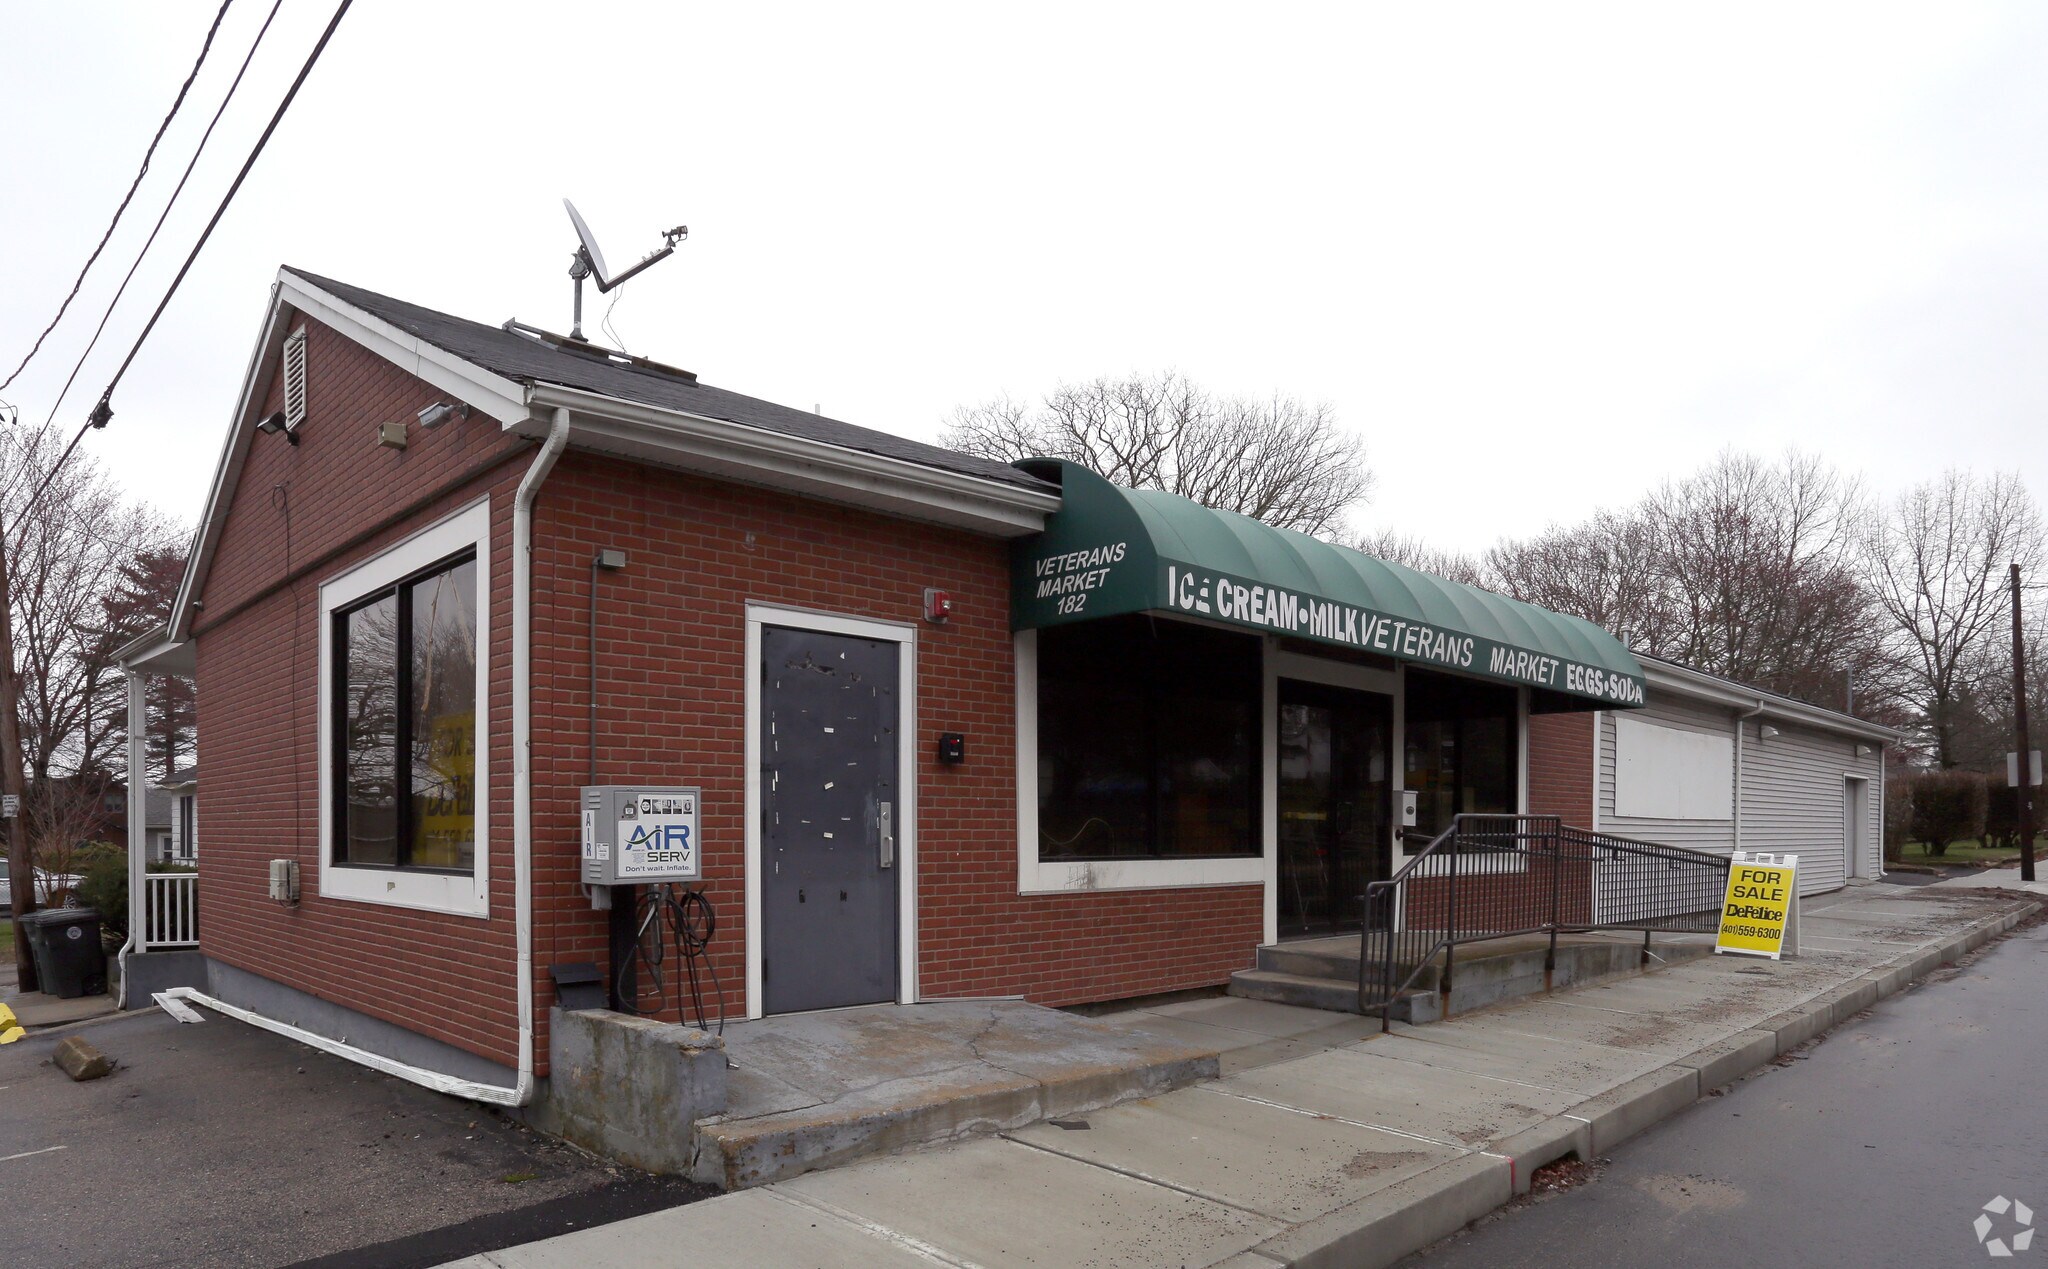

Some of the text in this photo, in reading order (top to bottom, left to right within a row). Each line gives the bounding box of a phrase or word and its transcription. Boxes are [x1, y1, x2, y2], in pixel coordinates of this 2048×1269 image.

[1036, 542, 1126, 577] VETERANS
[1037, 568, 1110, 598] MARKET
[1058, 594, 1086, 615] 182
[1361, 613, 1474, 667] VETERANS
[1490, 647, 1559, 685] MARKET
[647, 851, 691, 863] SERV
[1741, 869, 1781, 884] FOR
[1733, 885, 1783, 901] SALE
[1726, 903, 1782, 922] DeFelice
